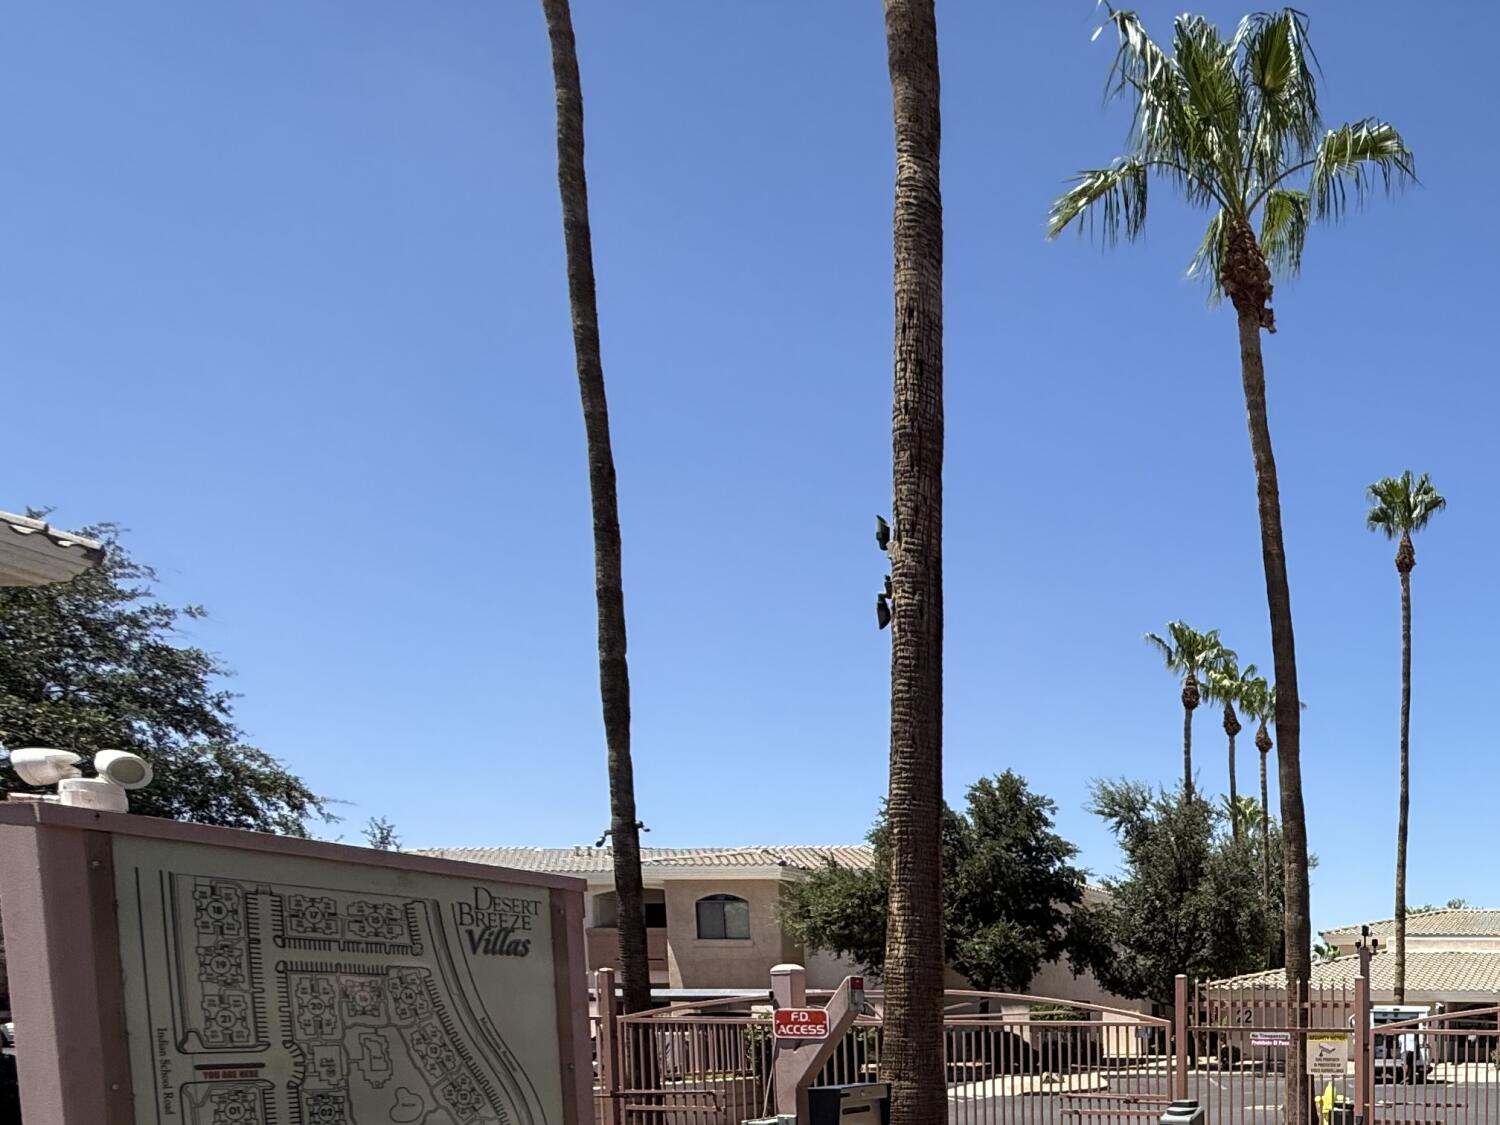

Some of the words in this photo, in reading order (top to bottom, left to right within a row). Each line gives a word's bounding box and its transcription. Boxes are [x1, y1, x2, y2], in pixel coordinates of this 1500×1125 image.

[472, 886, 542, 916] DESERT
[456, 901, 532, 931] BREEZE
[464, 928, 532, 957] Villas
[157, 1028, 169, 1056] Indian
[777, 1024, 826, 1035] ACCESS
[160, 1059, 173, 1088] School
[163, 1092, 176, 1115] Road
[230, 1106, 241, 1115] 01
[320, 1108, 332, 1117] 02
